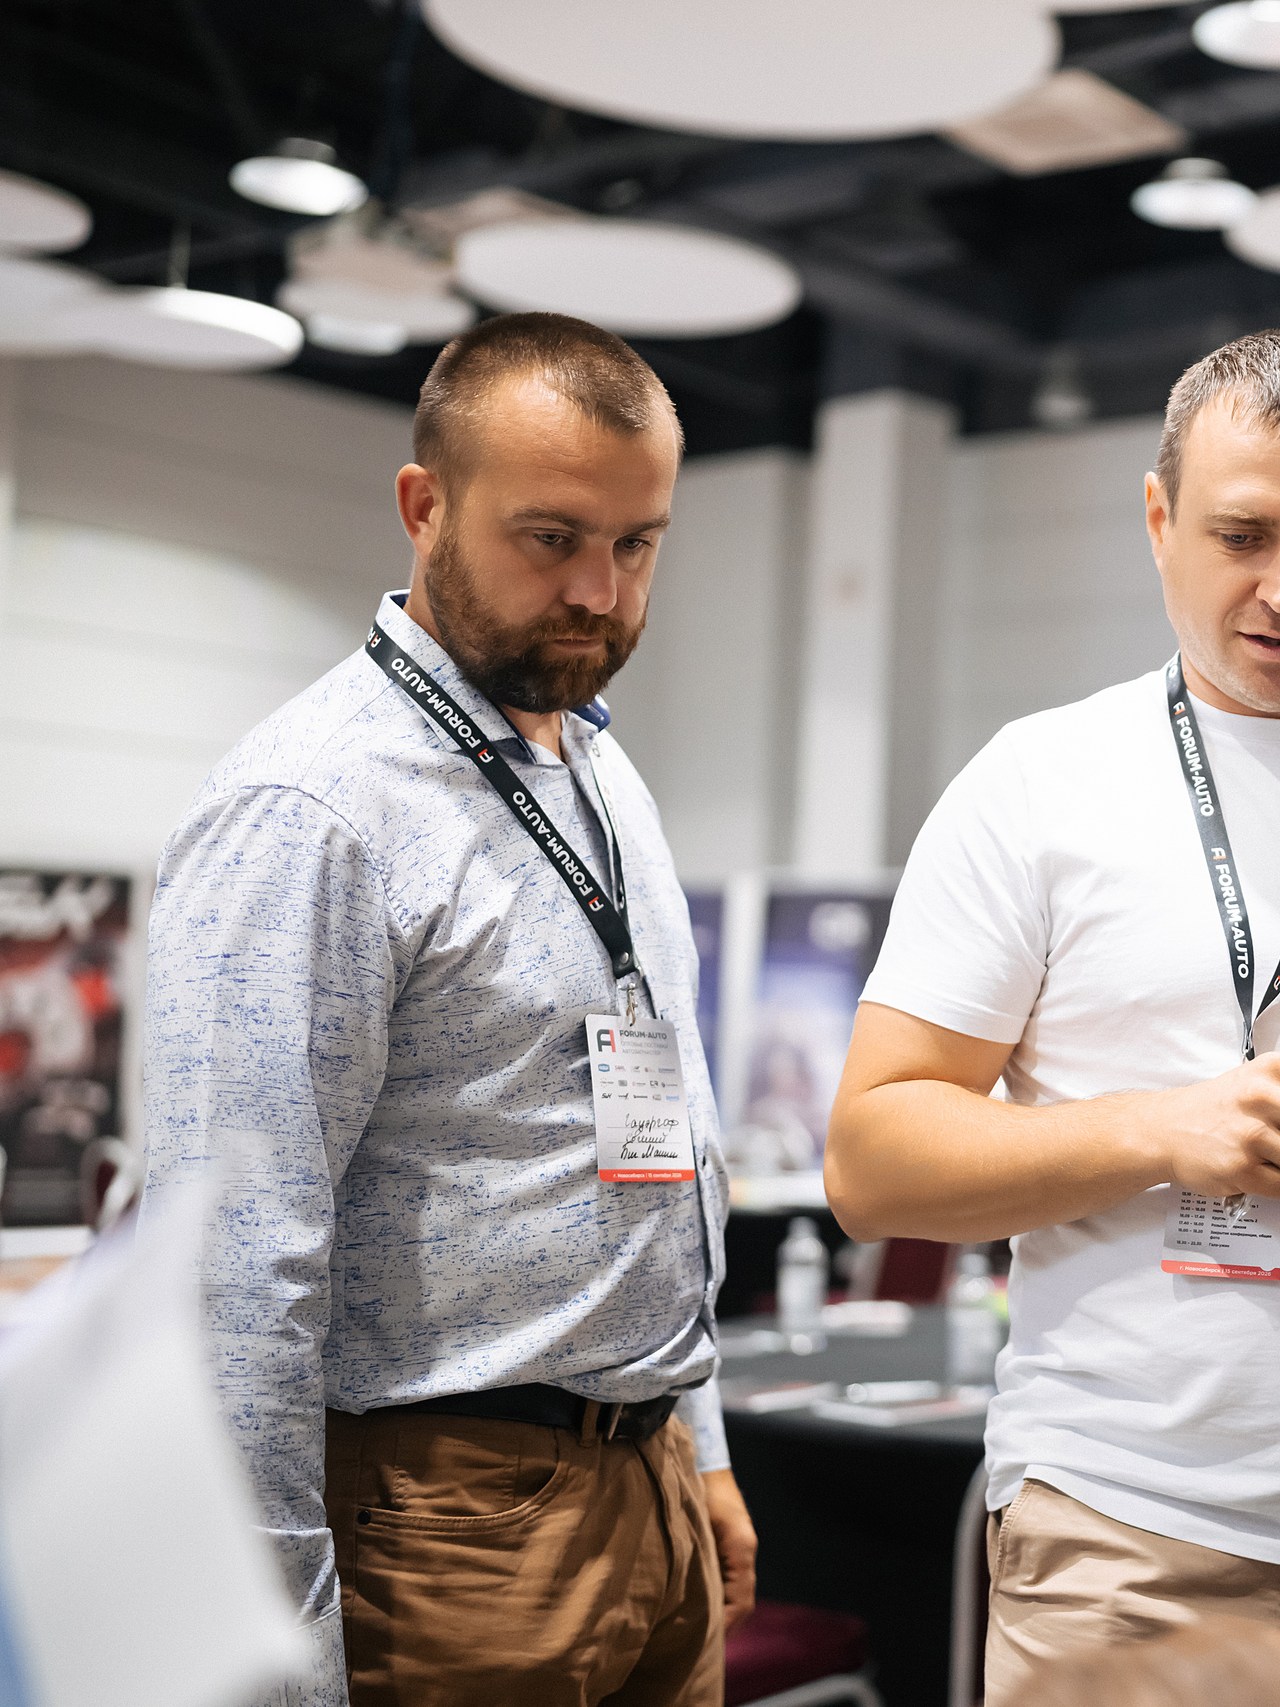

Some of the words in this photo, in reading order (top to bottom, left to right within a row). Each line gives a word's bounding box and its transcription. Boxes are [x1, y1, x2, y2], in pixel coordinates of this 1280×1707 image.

[391, 657, 482, 749] FORUM-AUTO
[1176, 716, 1214, 817] FORUM-AUTO
[512, 790, 593, 897] FORUM-AUTO
[1215, 863, 1248, 979] FORUM-AUTO
[619, 1030, 667, 1040] FORUM-AUTO
